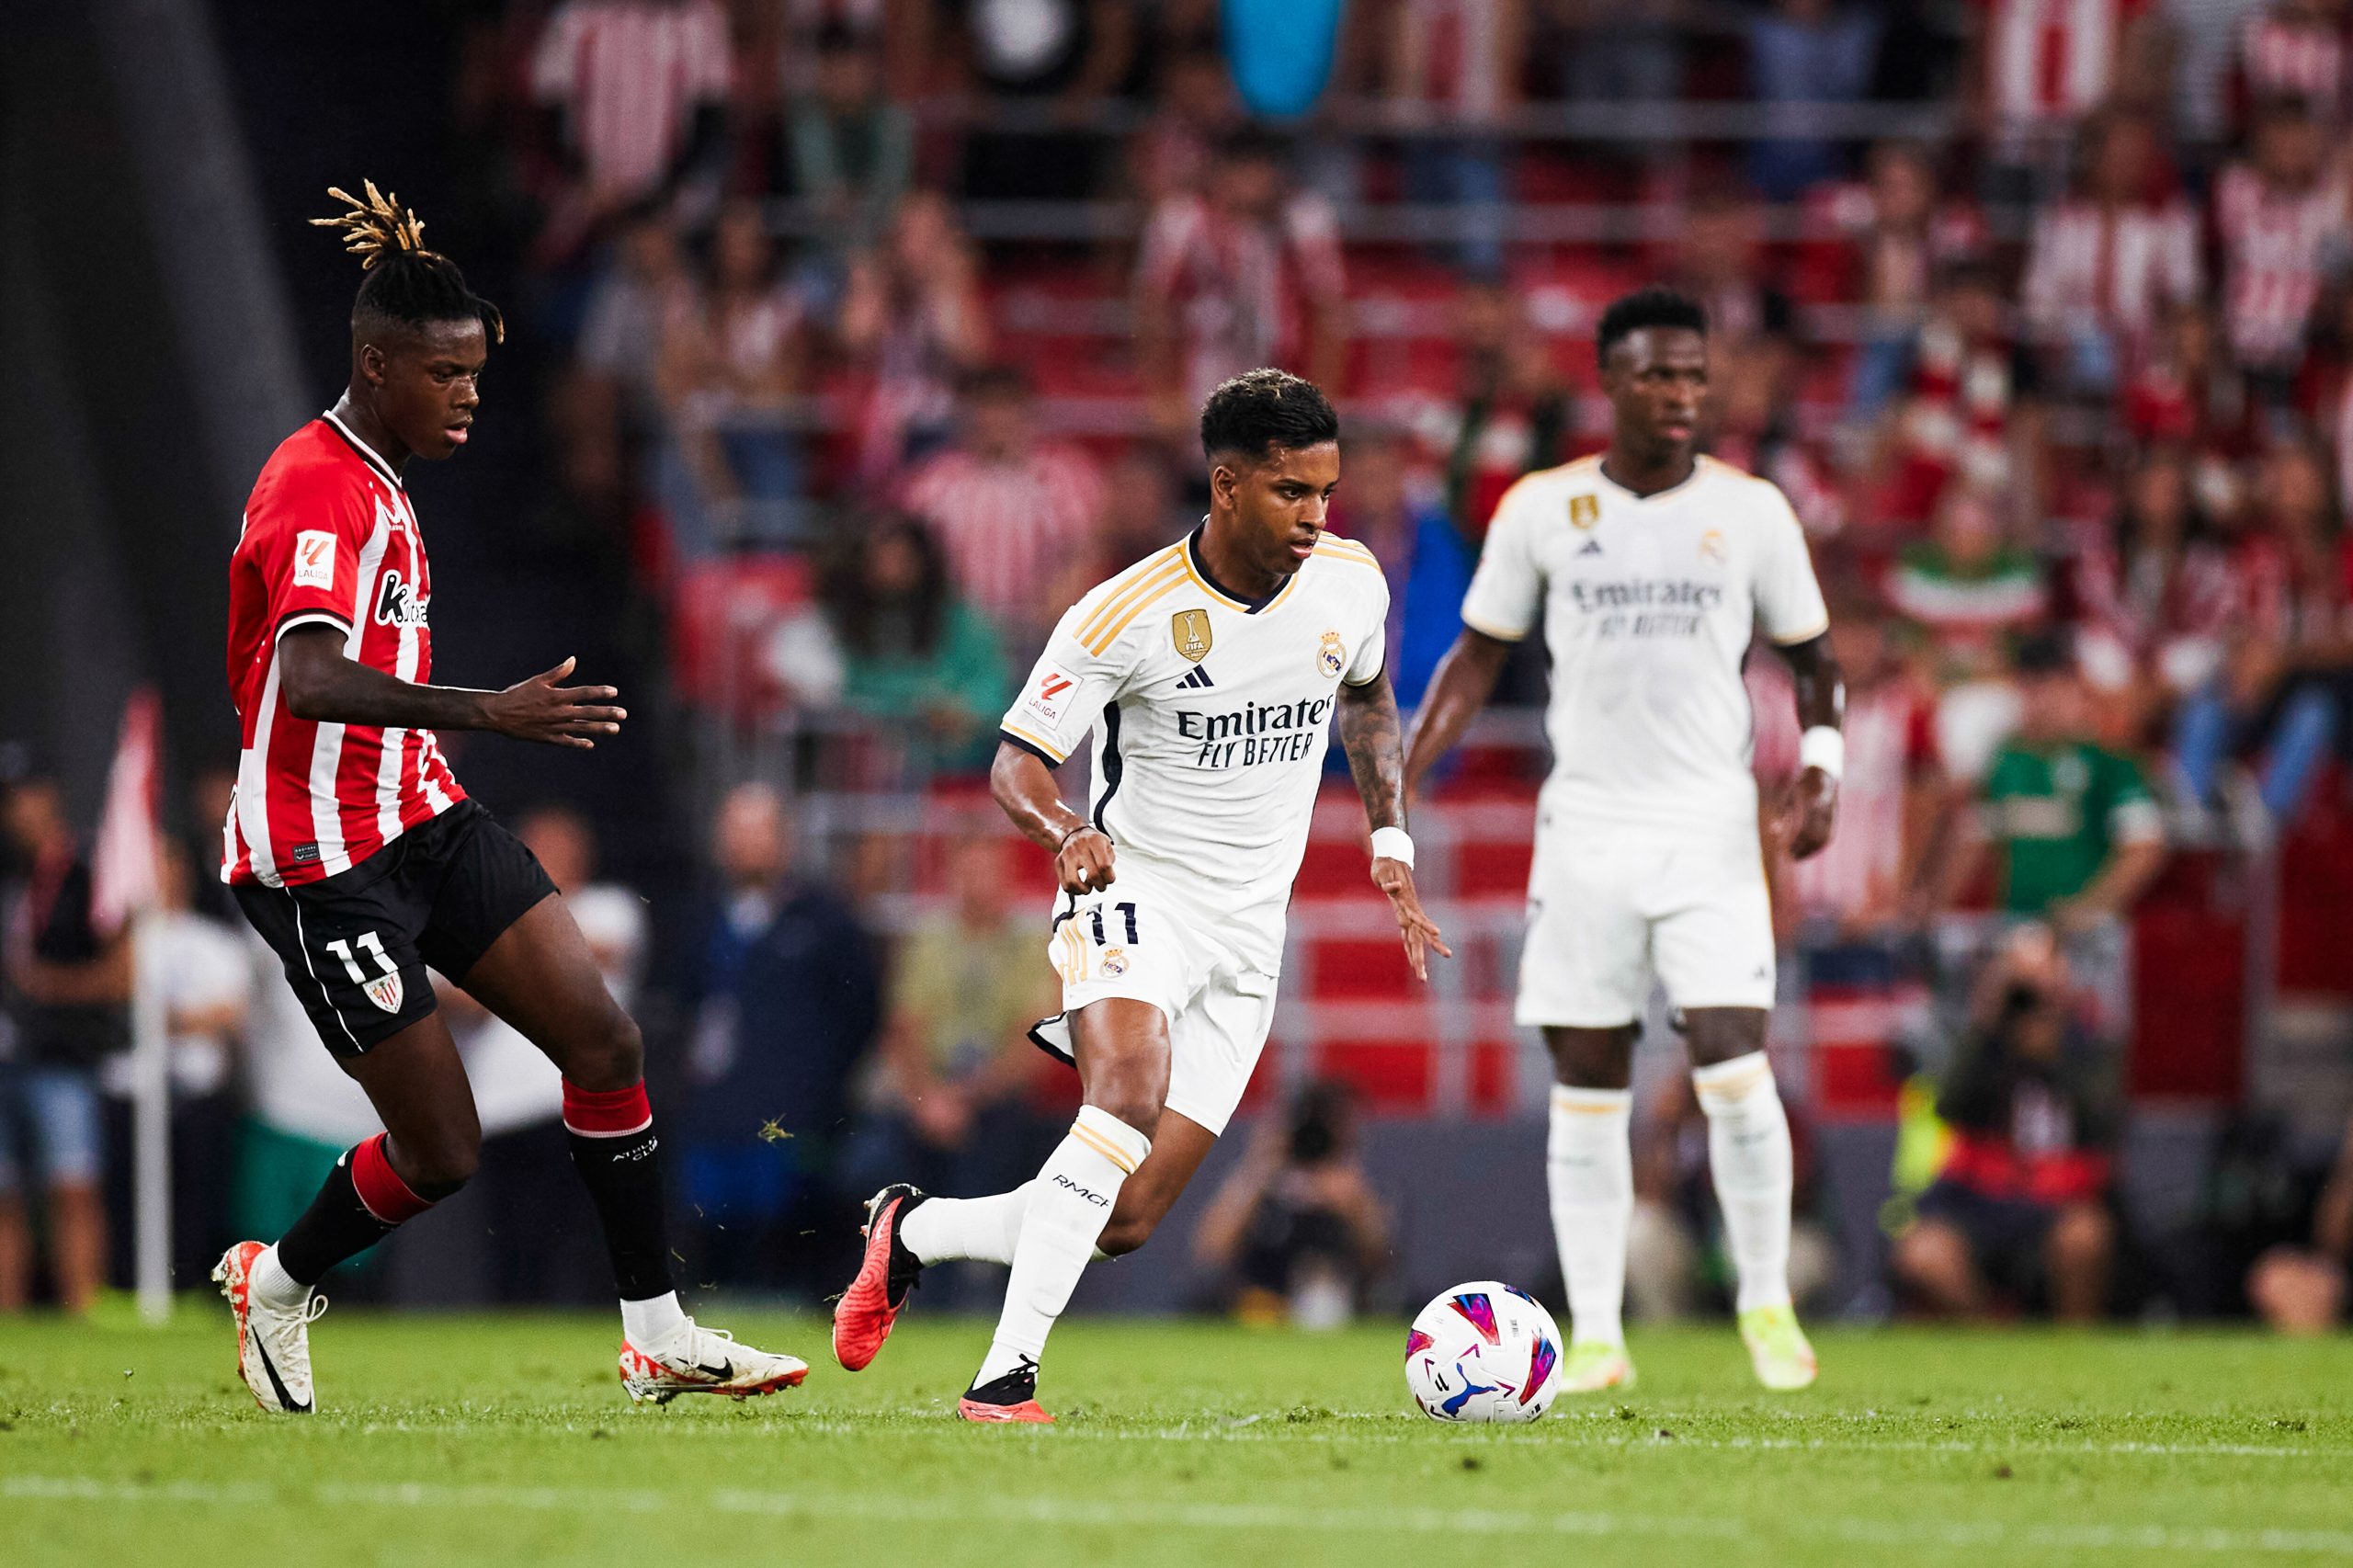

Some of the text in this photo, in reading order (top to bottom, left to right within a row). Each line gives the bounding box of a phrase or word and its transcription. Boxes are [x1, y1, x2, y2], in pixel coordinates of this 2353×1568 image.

[1185, 642, 1204, 651] FIFA
[1029, 698, 1057, 720] LALIGA
[1199, 733, 1313, 768] FLY BETTER
[1086, 902, 1139, 947] 11
[325, 930, 399, 985] 11
